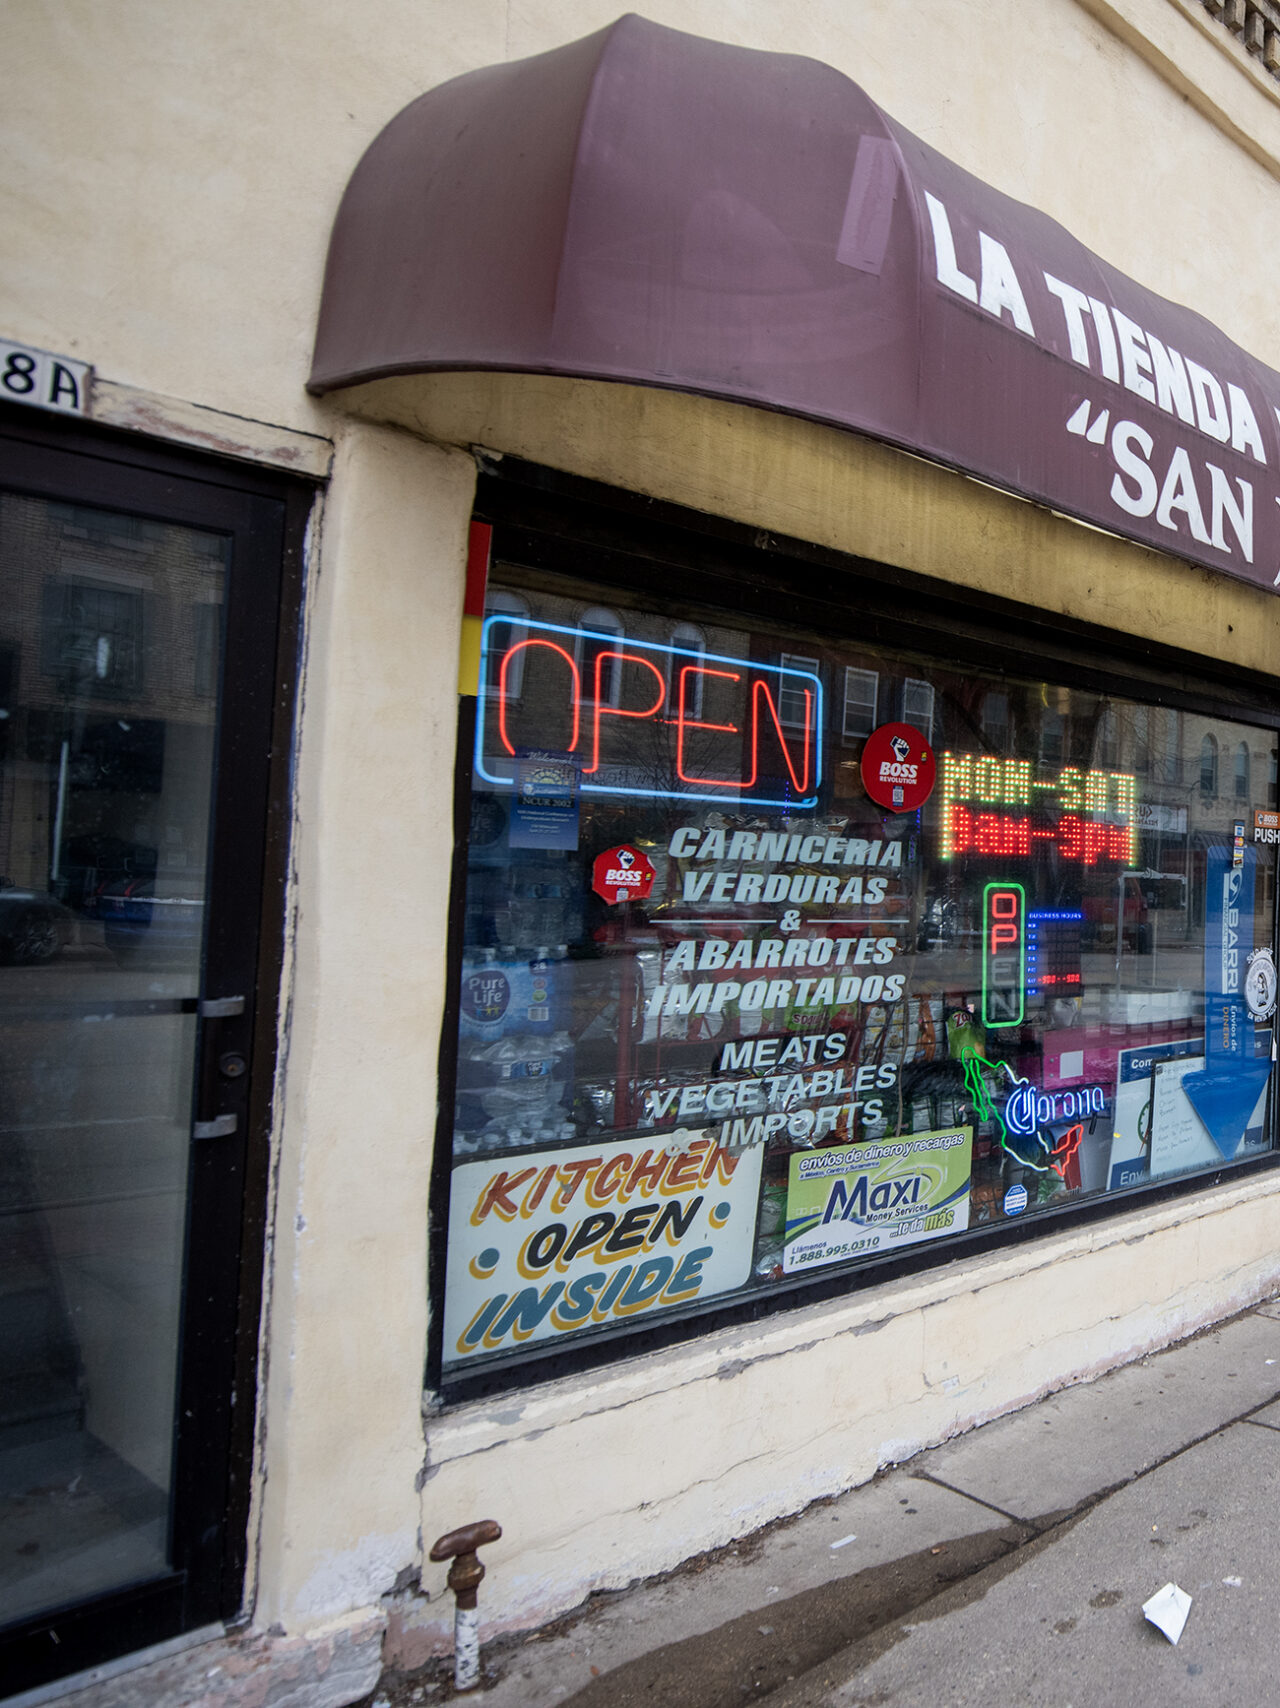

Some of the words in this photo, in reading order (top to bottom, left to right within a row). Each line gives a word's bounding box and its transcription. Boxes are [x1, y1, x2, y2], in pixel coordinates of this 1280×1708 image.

[924, 189, 1038, 338] LA
[1043, 271, 1267, 463] TIENDA
[2, 352, 79, 409] 8A
[500, 638, 812, 793] OPEN
[879, 761, 918, 778] BOSS
[879, 776, 917, 784] REVOLUTION
[668, 827, 902, 867] CARNICERIA
[1254, 828, 1280, 843] PUSH
[605, 869, 642, 881] BOSS
[682, 872, 888, 904] VERDURAS
[780, 910, 801, 931] &
[665, 937, 898, 971] ABARROTES
[992, 893, 1017, 1019] OPEN
[1228, 907, 1242, 994] BARRI
[469, 977, 505, 990] Pure
[473, 989, 503, 1006] Life
[648, 974, 906, 1016] IMPORTADOS
[719, 1033, 847, 1070] MEATS
[650, 1063, 897, 1119] VEGETABLES
[1005, 1087, 1104, 1134] Corona
[719, 1100, 883, 1150] IMPORTS
[800, 1150, 844, 1172] envíos
[845, 1147, 862, 1163] de
[863, 1143, 903, 1160] dinero
[902, 1143, 914, 1157] y
[913, 1133, 965, 1153] recargas
[471, 1140, 741, 1225] KITCHEN
[822, 1172, 922, 1225] Maxi
[865, 1209, 894, 1223] Money
[895, 1203, 928, 1217] Services
[909, 1217, 924, 1233] da
[924, 1207, 955, 1232] más
[518, 1196, 704, 1278] OPEN
[789, 1236, 880, 1265] 1.888.995.0310
[457, 1246, 713, 1352] INSIDE
